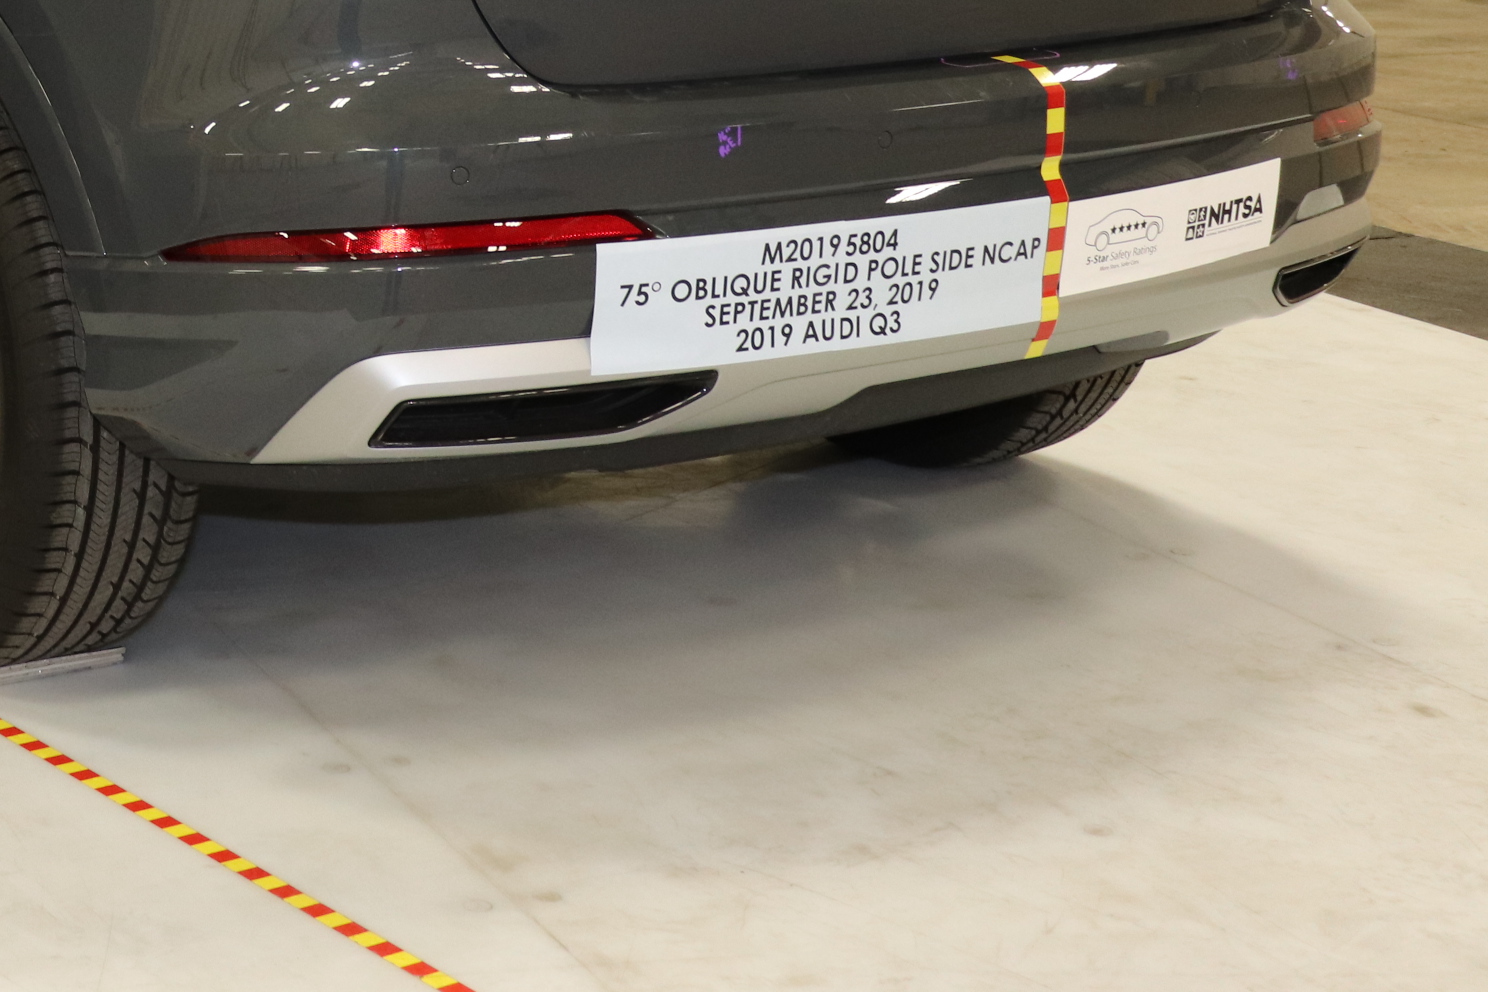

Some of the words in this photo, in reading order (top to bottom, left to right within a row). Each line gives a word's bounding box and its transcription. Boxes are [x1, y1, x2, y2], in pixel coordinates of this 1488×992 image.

[1208, 193, 1263, 228] NHTSA
[762, 228, 899, 265] M20195804
[1085, 254, 1109, 266] 5-Star
[1110, 248, 1131, 262] Safety
[1132, 244, 1157, 257] Ratings
[620, 281, 662, 307] 75°
[671, 270, 782, 303] OBLIQUE
[791, 262, 858, 290] RIGID
[867, 254, 923, 281] POLE
[929, 246, 975, 274] SIDE
[982, 237, 1041, 266] NCAP
[704, 290, 837, 328] SEPTEMBER
[846, 286, 878, 311] 23,
[887, 278, 939, 306] 2019
[735, 323, 793, 353] 2019
[802, 315, 860, 344] AUDI
[869, 310, 901, 336] Q3
